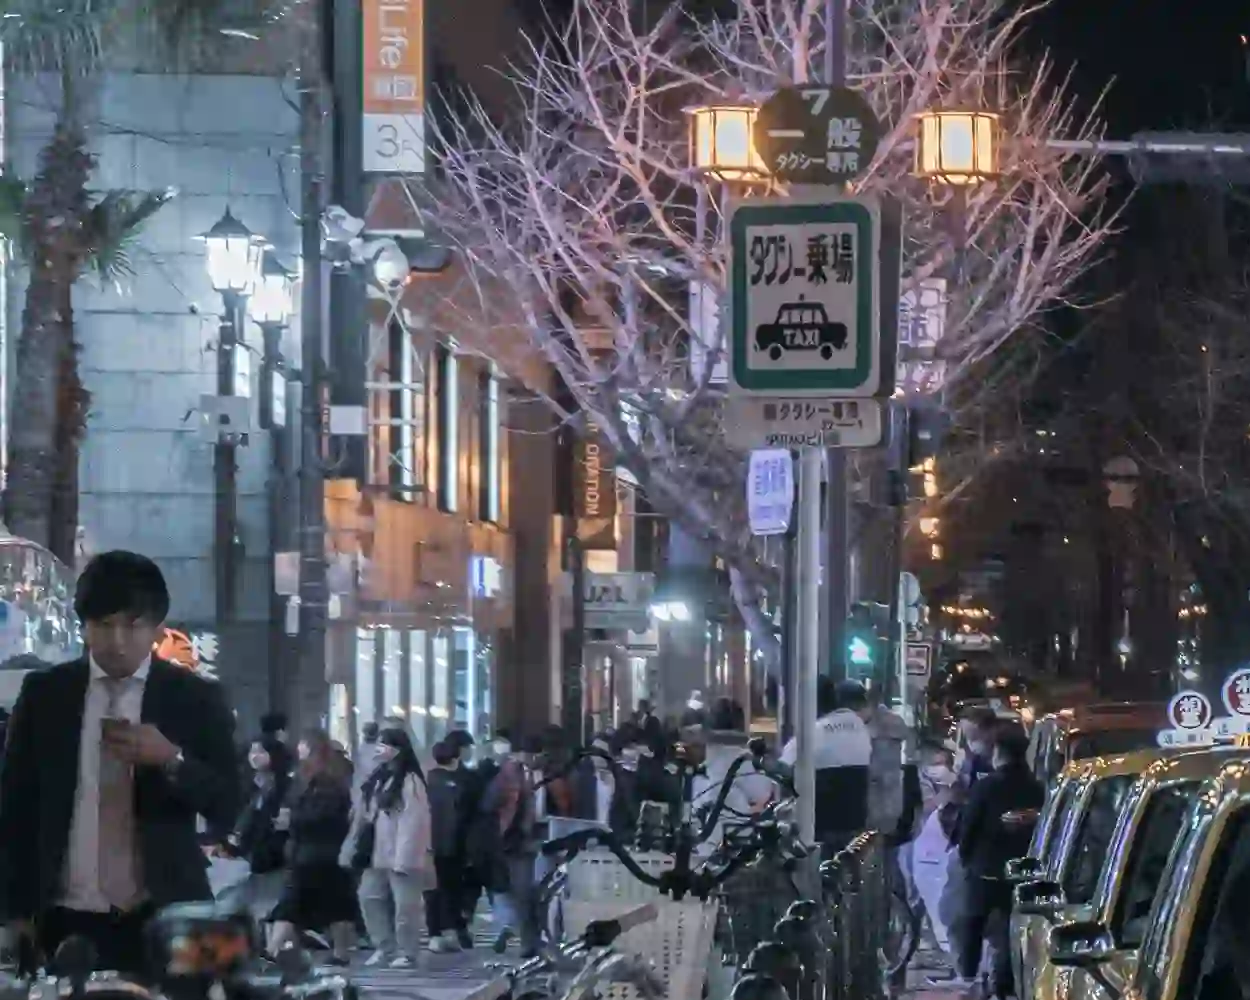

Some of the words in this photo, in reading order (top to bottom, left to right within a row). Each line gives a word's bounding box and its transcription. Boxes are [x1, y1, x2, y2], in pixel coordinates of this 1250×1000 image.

[800, 89, 830, 116] 7
[767, 117, 862, 149] 一般
[750, 233, 854, 286] タクシー乗場
[783, 328, 820, 346] TAXI
